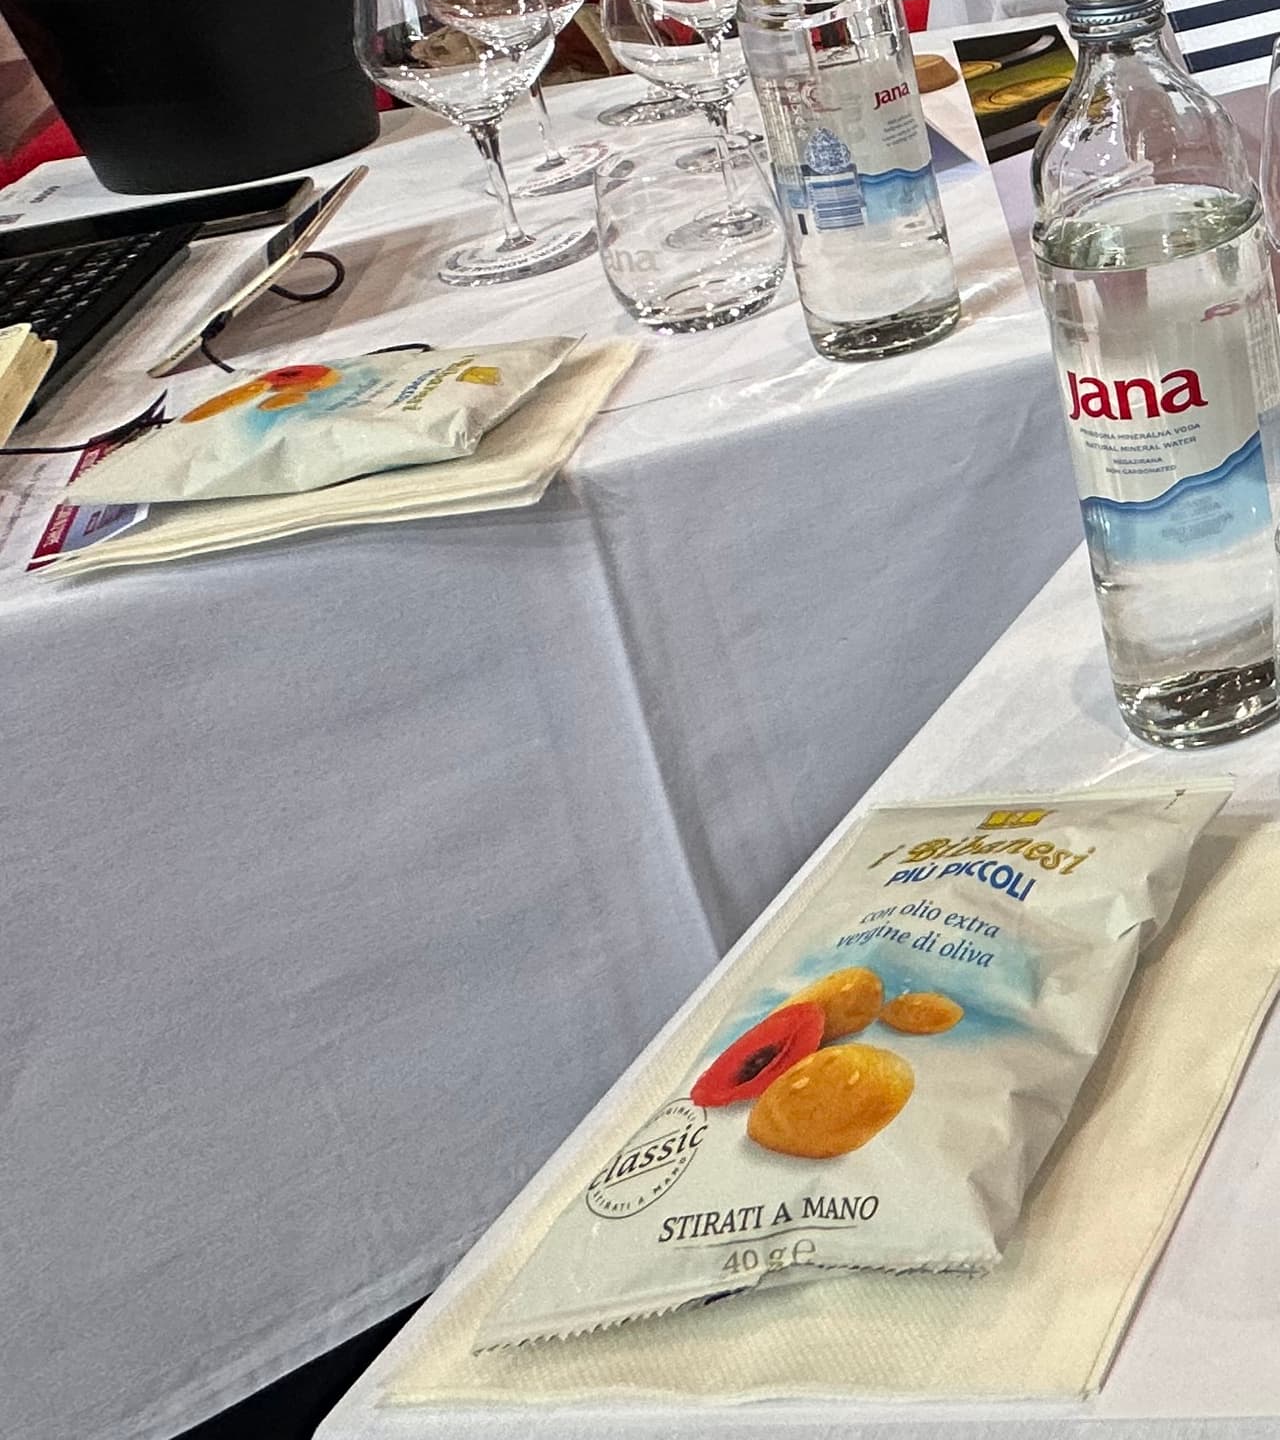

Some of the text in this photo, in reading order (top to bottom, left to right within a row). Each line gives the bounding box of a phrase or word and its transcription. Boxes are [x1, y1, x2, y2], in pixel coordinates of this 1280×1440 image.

[873, 81, 910, 111] Jana
[1066, 368, 1209, 421] Jana
[1161, 436, 1197, 450] WATER
[897, 833, 1097, 876] Bibanesi
[883, 859, 1037, 902] PIÙ PICCOLI
[859, 898, 1001, 939] con olio extra
[835, 920, 995, 968] vergine di oliva
[587, 1122, 708, 1191] classic
[657, 1195, 880, 1243] STIRATI A MANO
[722, 1249, 760, 1274] 40
